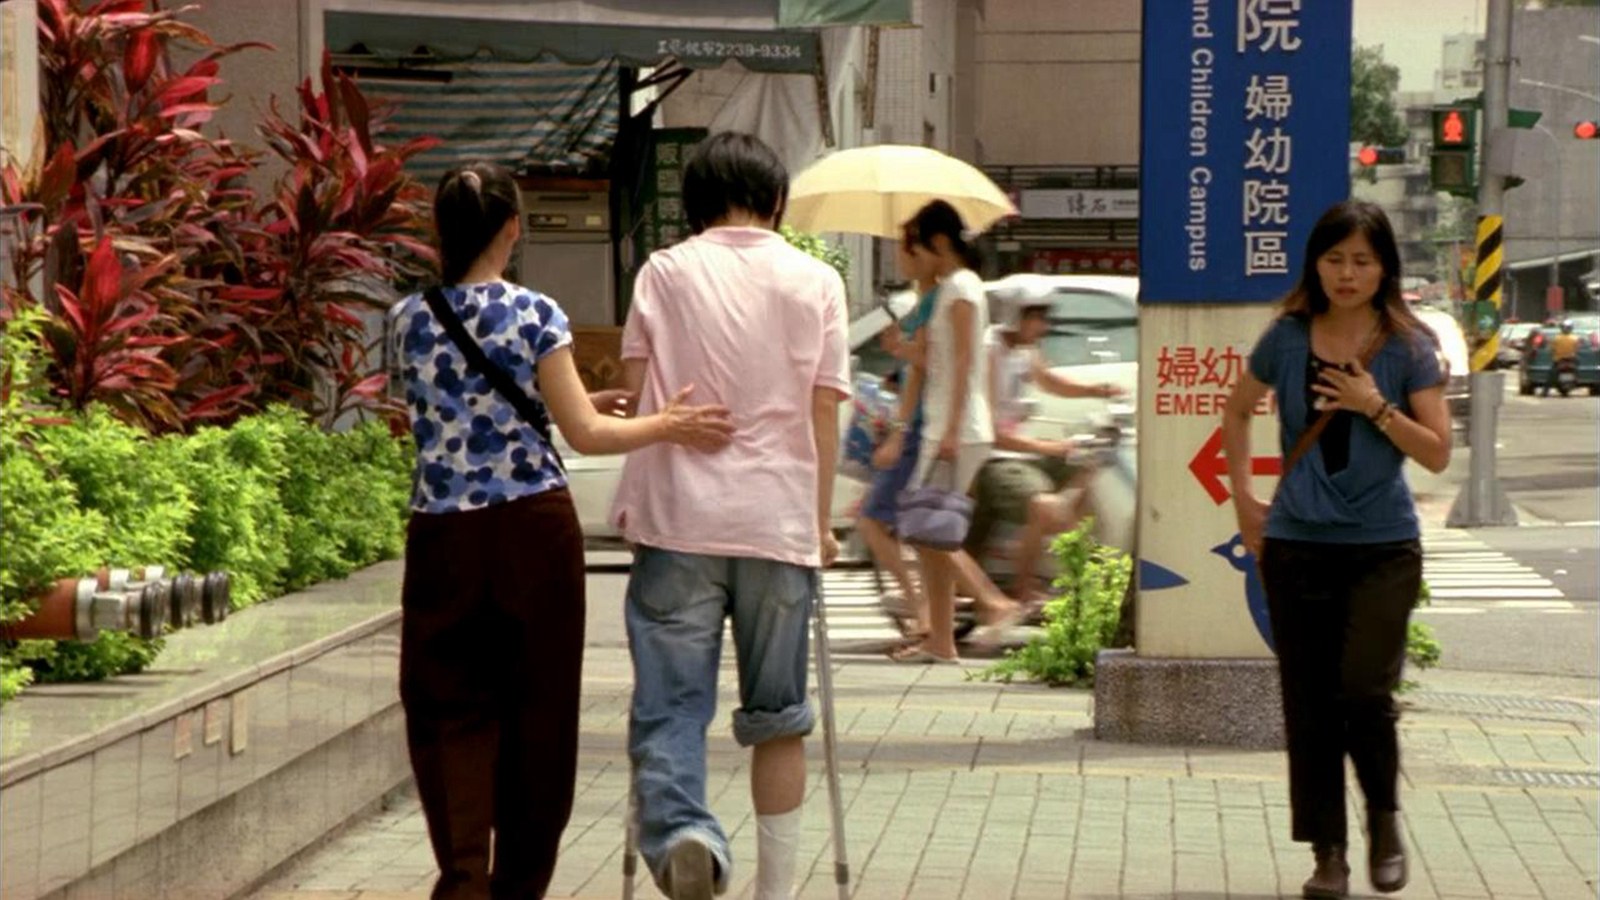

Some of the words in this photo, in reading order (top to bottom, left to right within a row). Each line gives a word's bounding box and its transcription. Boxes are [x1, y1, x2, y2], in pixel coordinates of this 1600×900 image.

[1193, 0, 1213, 38] nd
[1237, 0, 1301, 52] 院
[1190, 48, 1214, 156] Children
[1185, 167, 1212, 271] Campus
[1243, 75, 1292, 276] 婦幼院區
